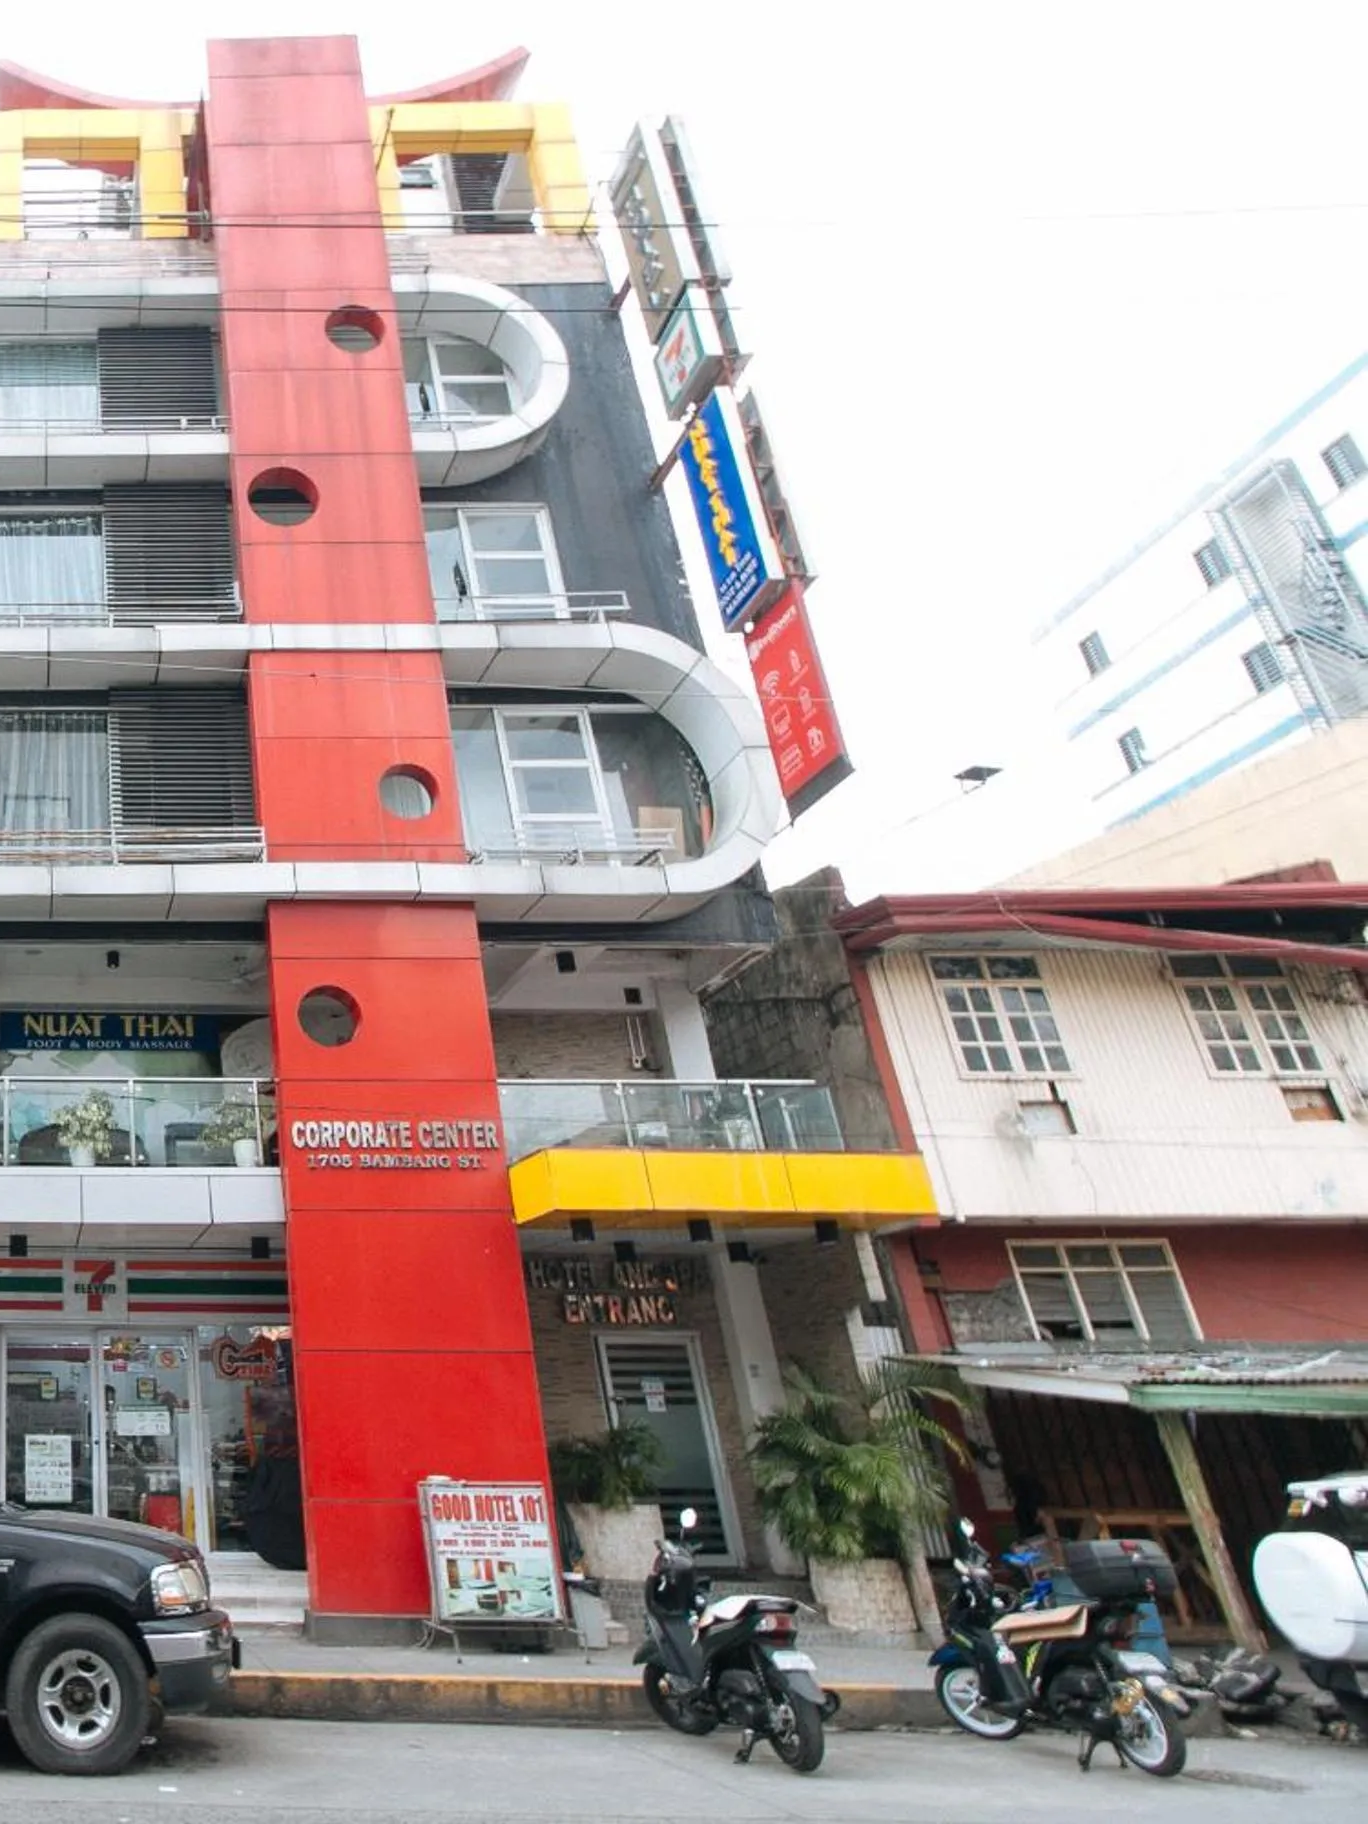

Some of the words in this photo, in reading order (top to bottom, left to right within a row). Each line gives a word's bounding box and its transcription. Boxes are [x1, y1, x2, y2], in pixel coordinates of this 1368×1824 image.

[25, 1014, 106, 1037] NUAT
[120, 1014, 194, 1037] THAI
[27, 1039, 64, 1049] FOOT
[69, 1039, 81, 1049] &
[87, 1039, 123, 1049] BODY
[129, 1039, 193, 1049] MASSAGE
[292, 1120, 412, 1148] CORPORATE
[418, 1120, 500, 1149] CENTER
[307, 1154, 352, 1168] 1705
[359, 1154, 452, 1168] BAMBANG
[459, 1154, 487, 1168] ST.
[74, 1260, 116, 1311] 7
[432, 1493, 471, 1521] GOOD
[474, 1494, 518, 1521] HOTEL
[519, 1494, 545, 1522] 101
